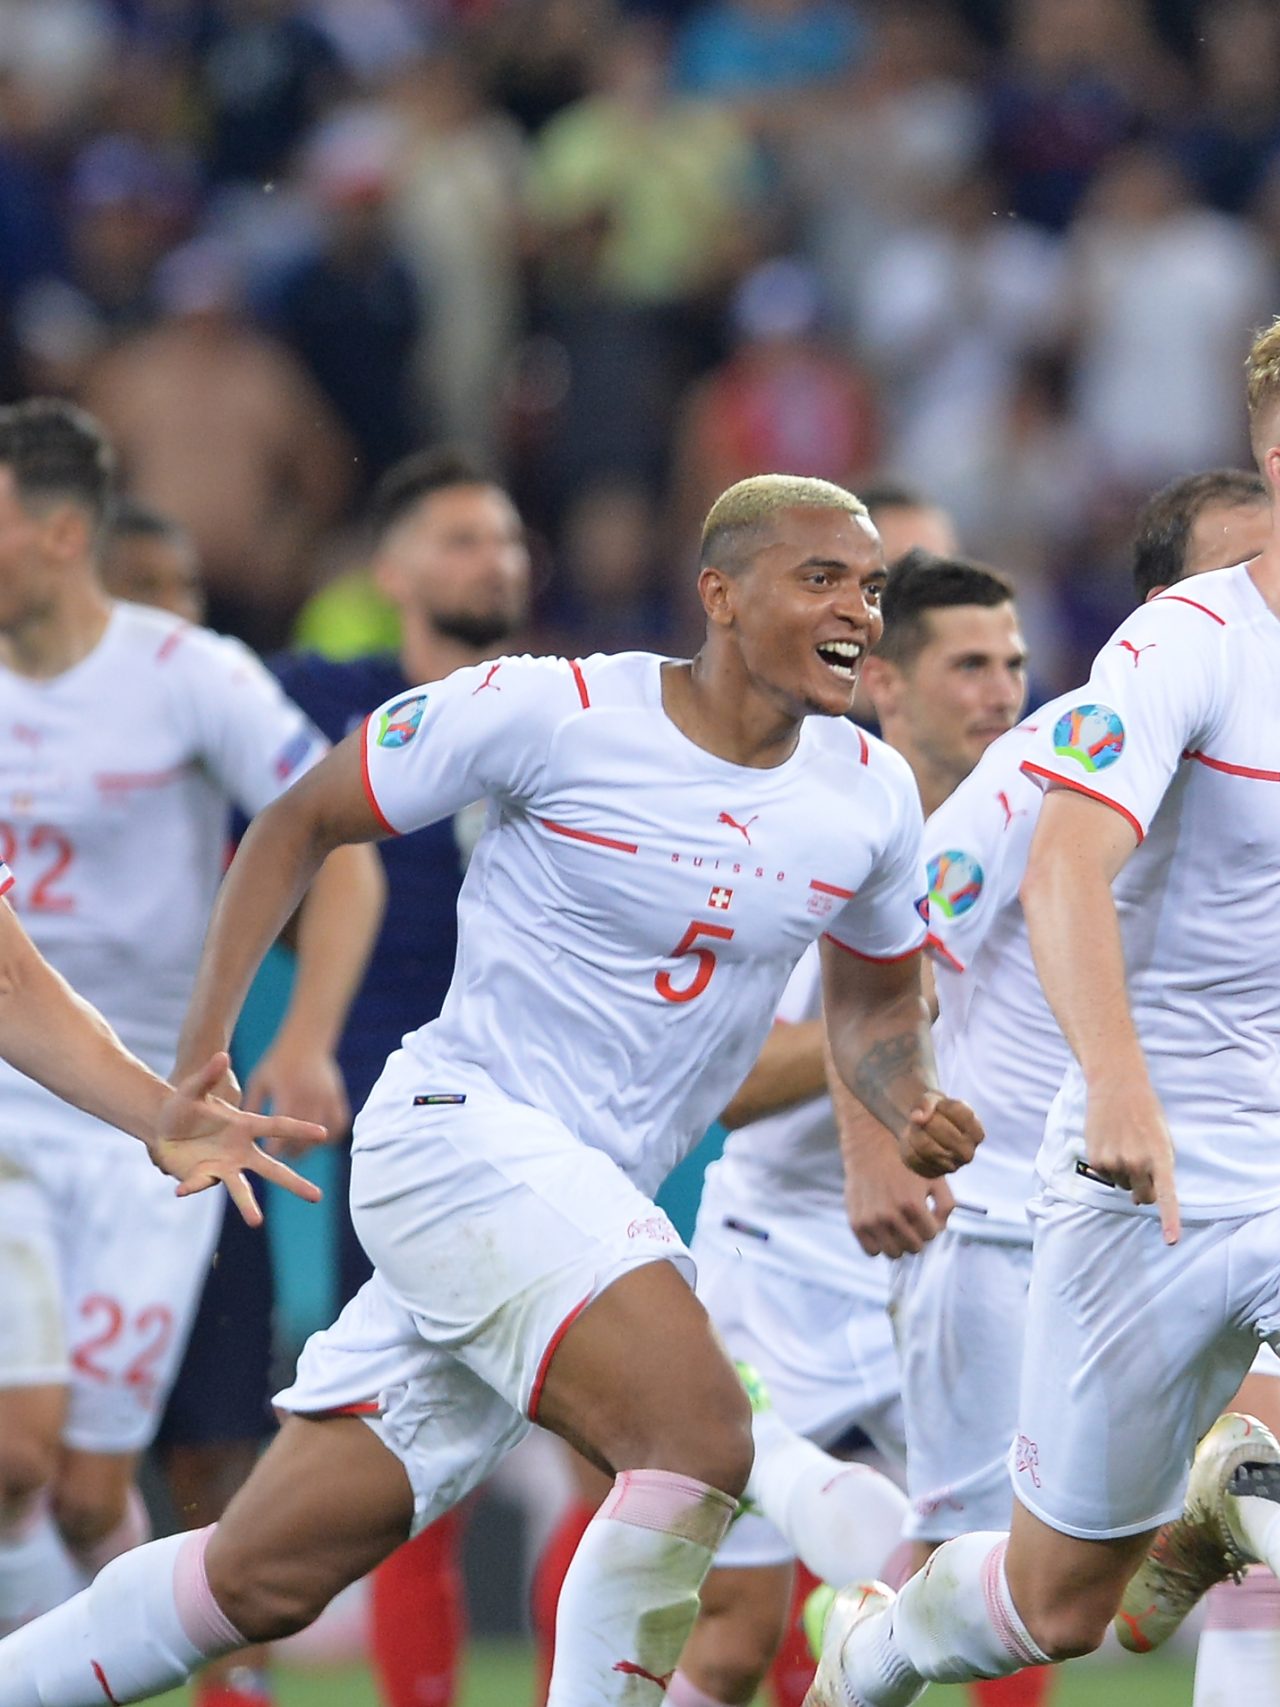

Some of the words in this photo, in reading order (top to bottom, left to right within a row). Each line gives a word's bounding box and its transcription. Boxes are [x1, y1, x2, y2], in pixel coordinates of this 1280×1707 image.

[671, 852, 785, 882] suisse
[654, 920, 735, 1004] 5
[70, 1292, 173, 1411] 22
